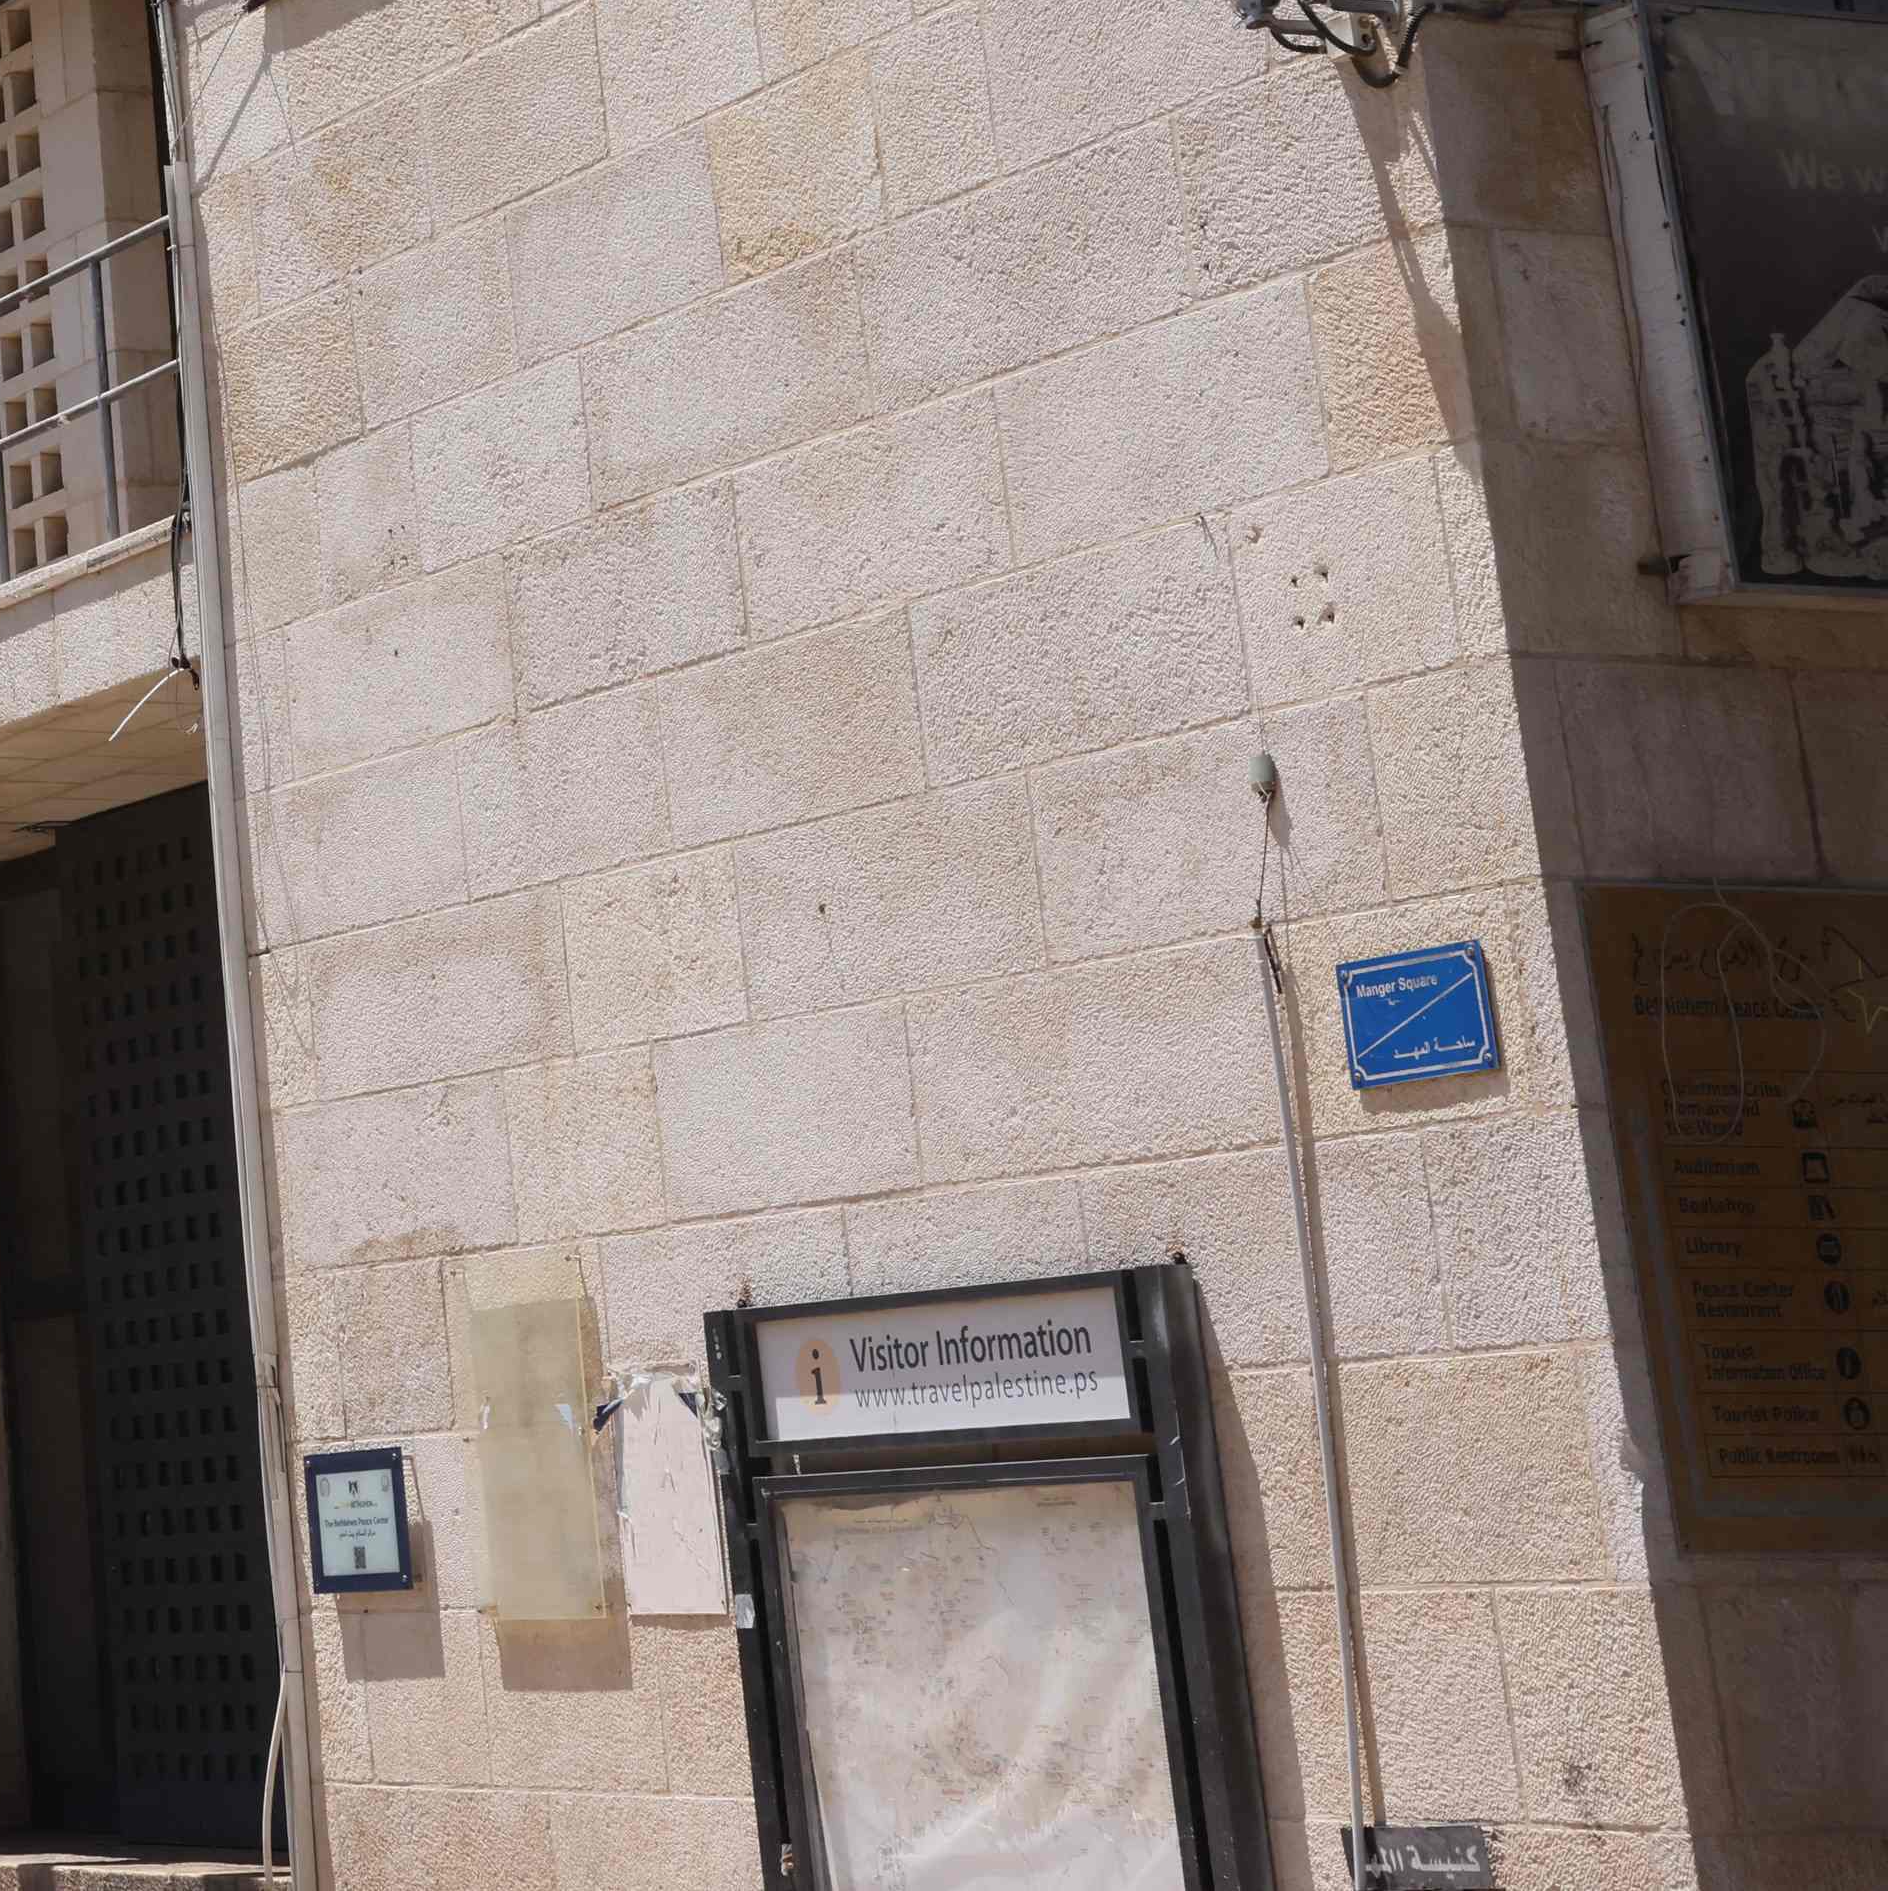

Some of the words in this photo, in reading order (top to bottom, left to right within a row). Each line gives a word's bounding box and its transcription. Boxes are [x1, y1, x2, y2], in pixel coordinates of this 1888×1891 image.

[1355, 982, 1396, 998] Manger
[1398, 973, 1439, 992] Square
[849, 1334, 929, 1373] Visitor
[935, 1318, 1093, 1366] Information
[855, 1368, 1099, 1409] www.travelpalestine.ps
